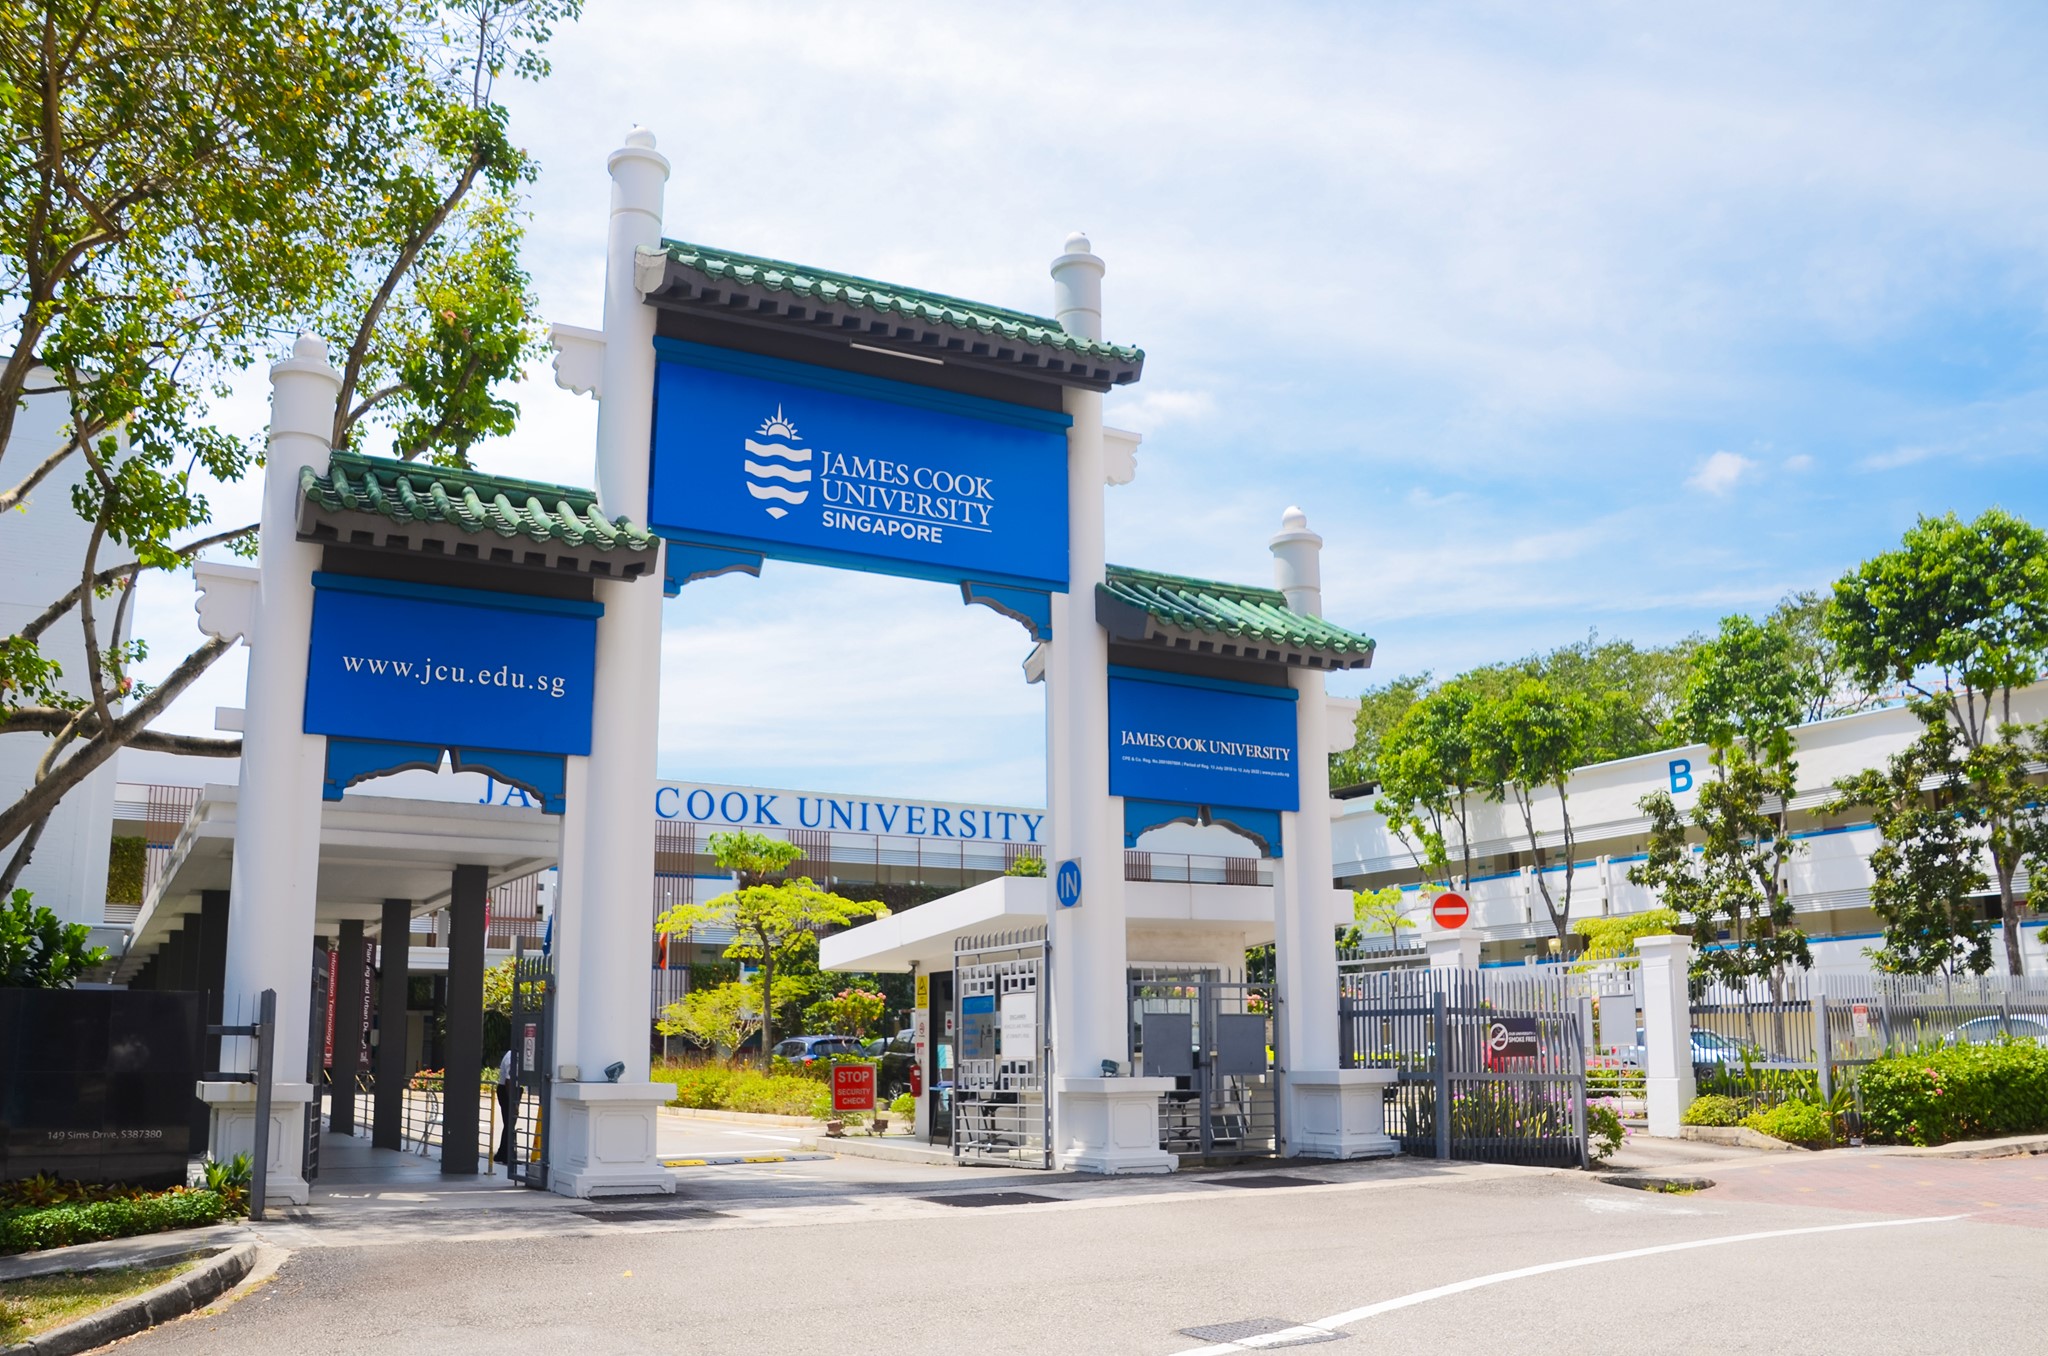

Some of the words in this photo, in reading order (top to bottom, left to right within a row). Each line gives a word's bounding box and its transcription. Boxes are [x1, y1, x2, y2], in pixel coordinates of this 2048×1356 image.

[820, 450, 909, 486] JAMES
[913, 467, 994, 500] COOK
[820, 478, 994, 526] UNIVERSITY
[822, 511, 942, 544] SINGAPORE
[343, 655, 566, 697] www.jcu.edu.sg
[1121, 731, 1165, 748] JAMES
[1167, 736, 1207, 752] COOK
[1209, 740, 1290, 761] UNIVERSITY
[1669, 759, 1693, 794] B
[655, 786, 782, 826] COOK
[799, 796, 1045, 843] UNIVERSITY
[1060, 870, 1078, 899] IN
[329, 952, 337, 997] Information
[326, 999, 335, 1045] Technology
[363, 996, 371, 1020] Urban
[838, 1071, 870, 1083] STOP
[838, 1088, 870, 1096] SECURITY
[842, 1097, 866, 1105] CHECK
[47, 1131, 65, 1140] 149
[67, 1131, 90, 1140] Sims
[121, 1129, 163, 1139] S387380
